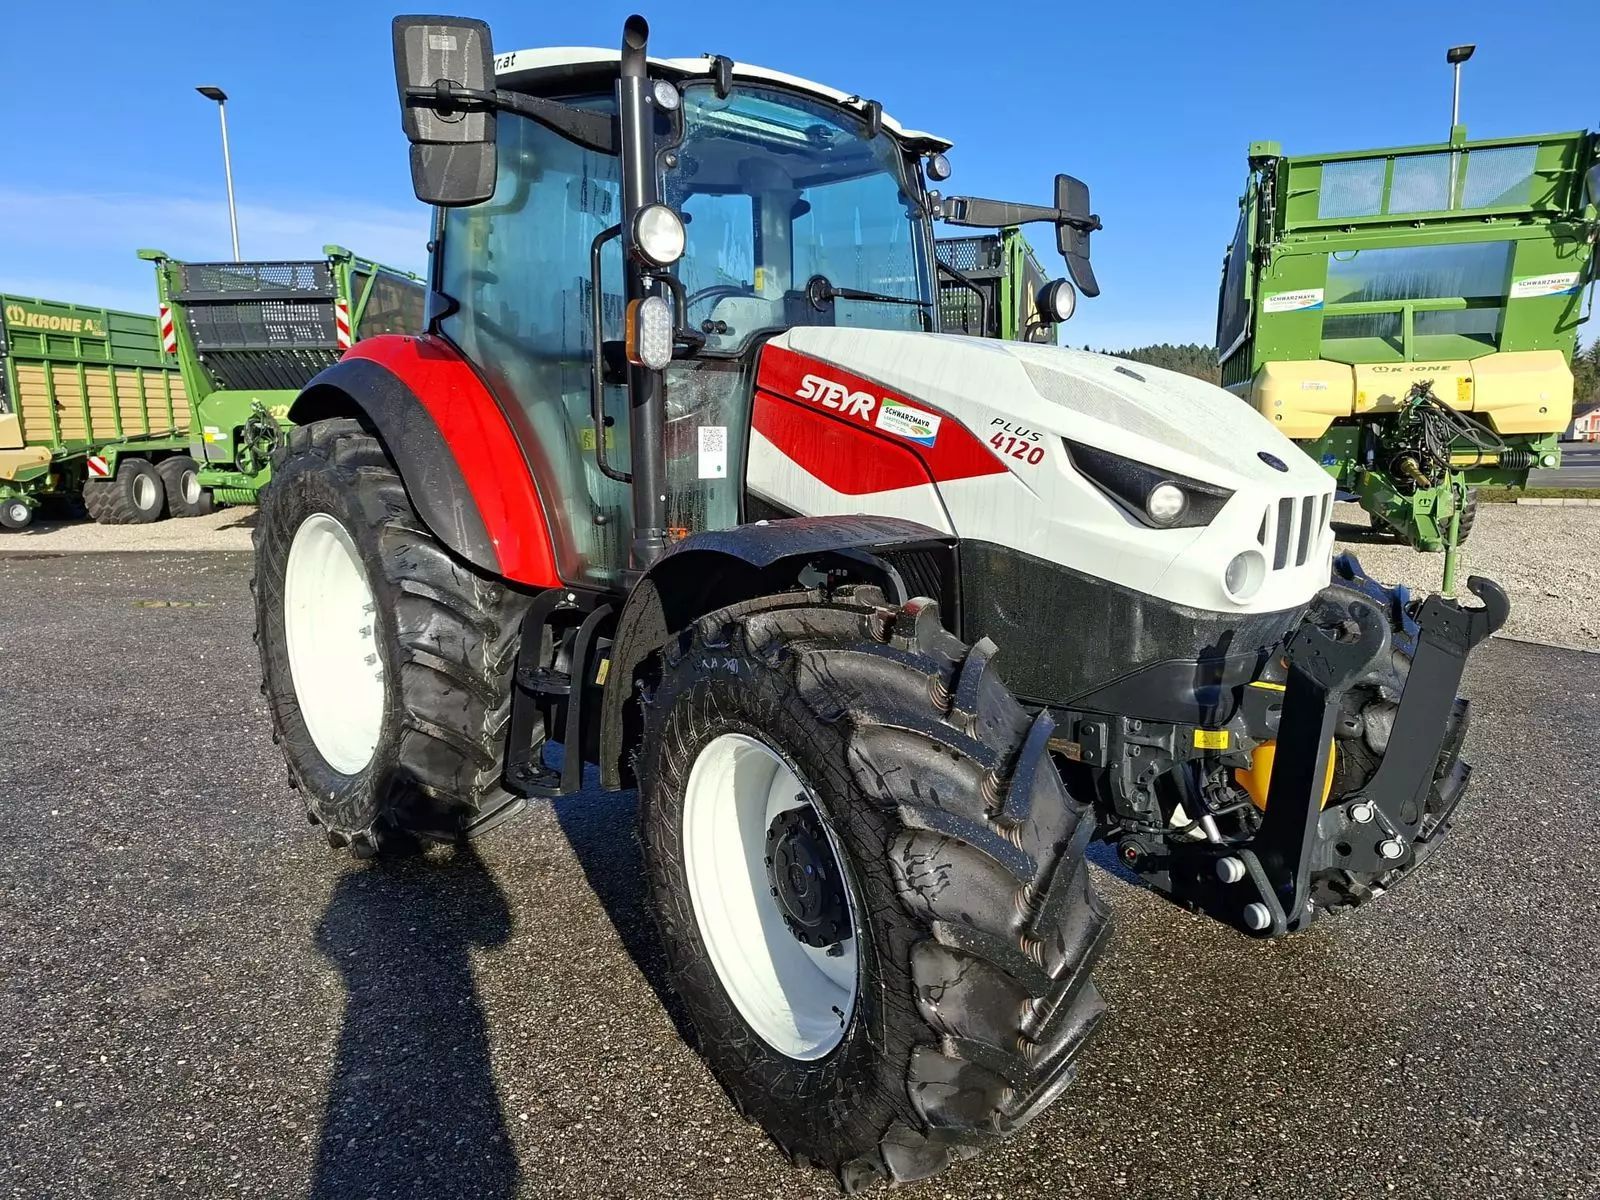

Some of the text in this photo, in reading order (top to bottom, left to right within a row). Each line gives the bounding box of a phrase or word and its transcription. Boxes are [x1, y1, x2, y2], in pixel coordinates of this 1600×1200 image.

[494, 53, 516, 70] r.at
[26, 313, 82, 332] KRONE
[795, 374, 876, 421] STEYR
[885, 407, 930, 428] SCHWARZMAYR
[990, 418, 1043, 441] PLUS
[990, 432, 1045, 465] 4120
